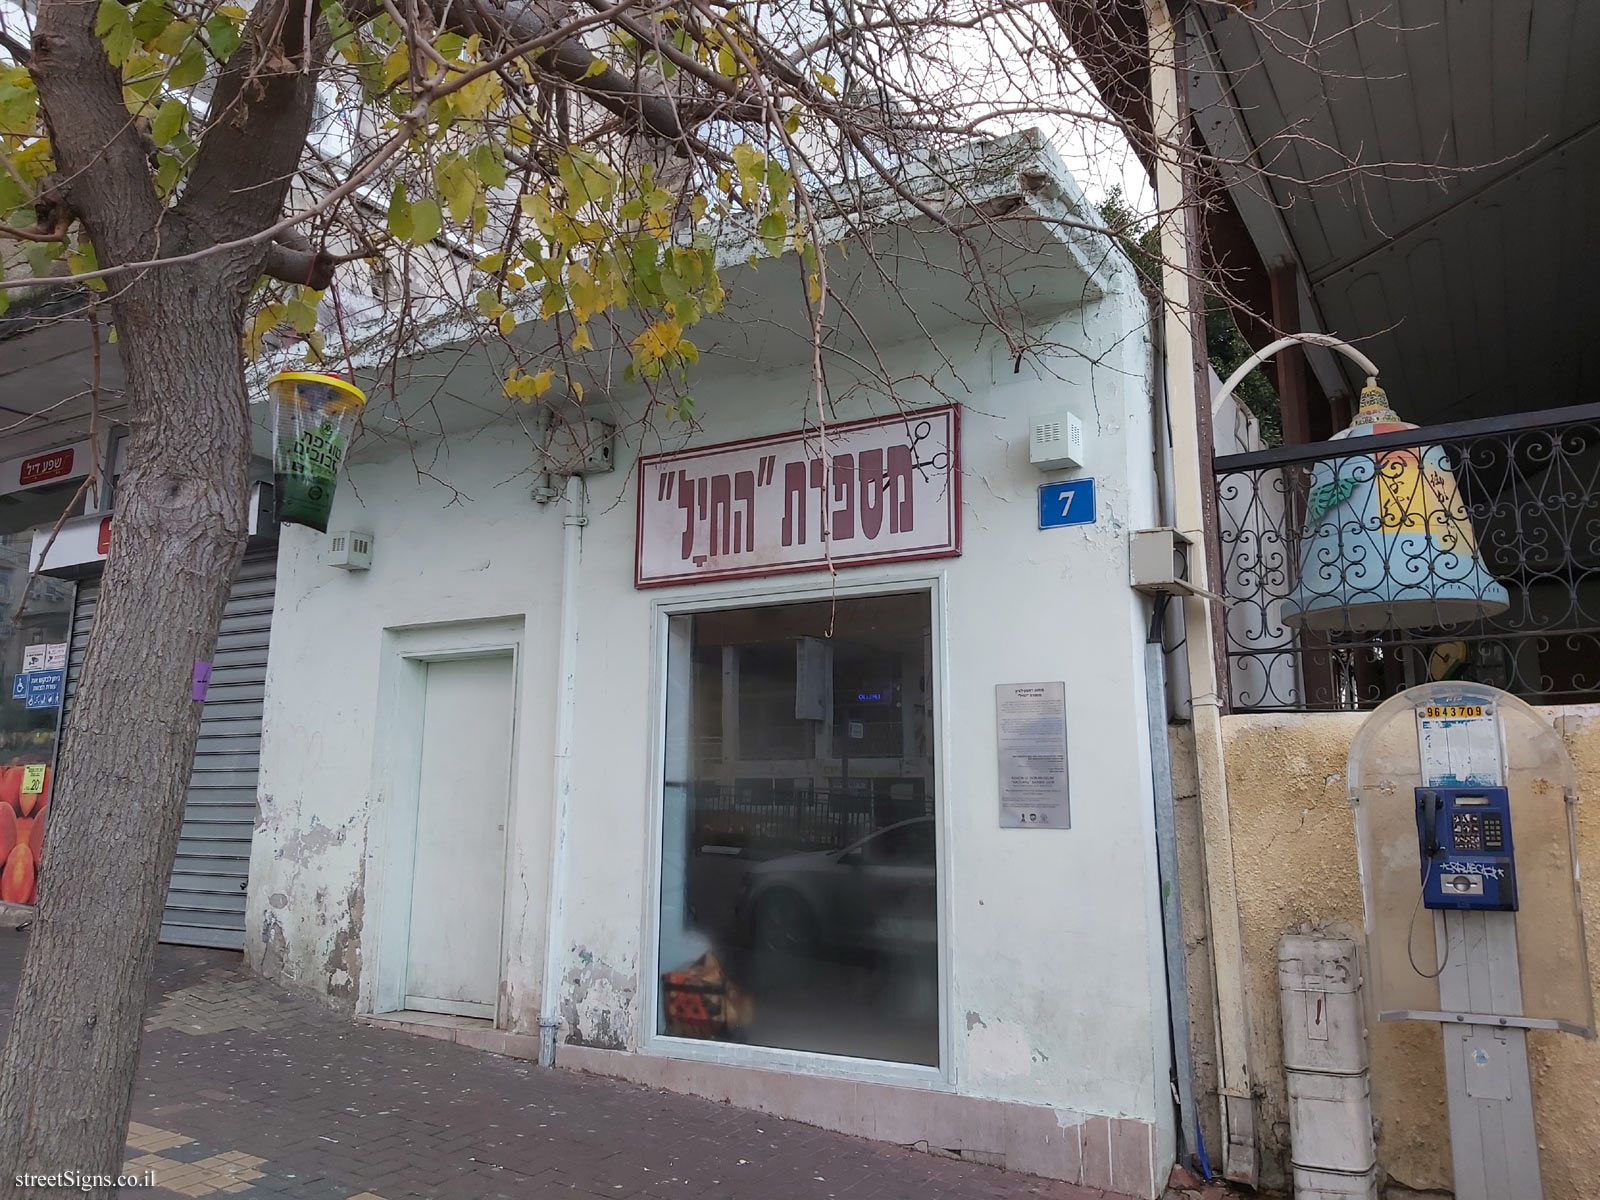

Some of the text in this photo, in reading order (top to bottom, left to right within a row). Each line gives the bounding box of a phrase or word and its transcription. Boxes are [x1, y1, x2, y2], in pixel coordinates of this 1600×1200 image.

[27, 457, 62, 475] שפע דיל
[782, 444, 913, 547] מספרת
[1058, 490, 1075, 517] 7
[1427, 706, 1482, 718] 9643709
